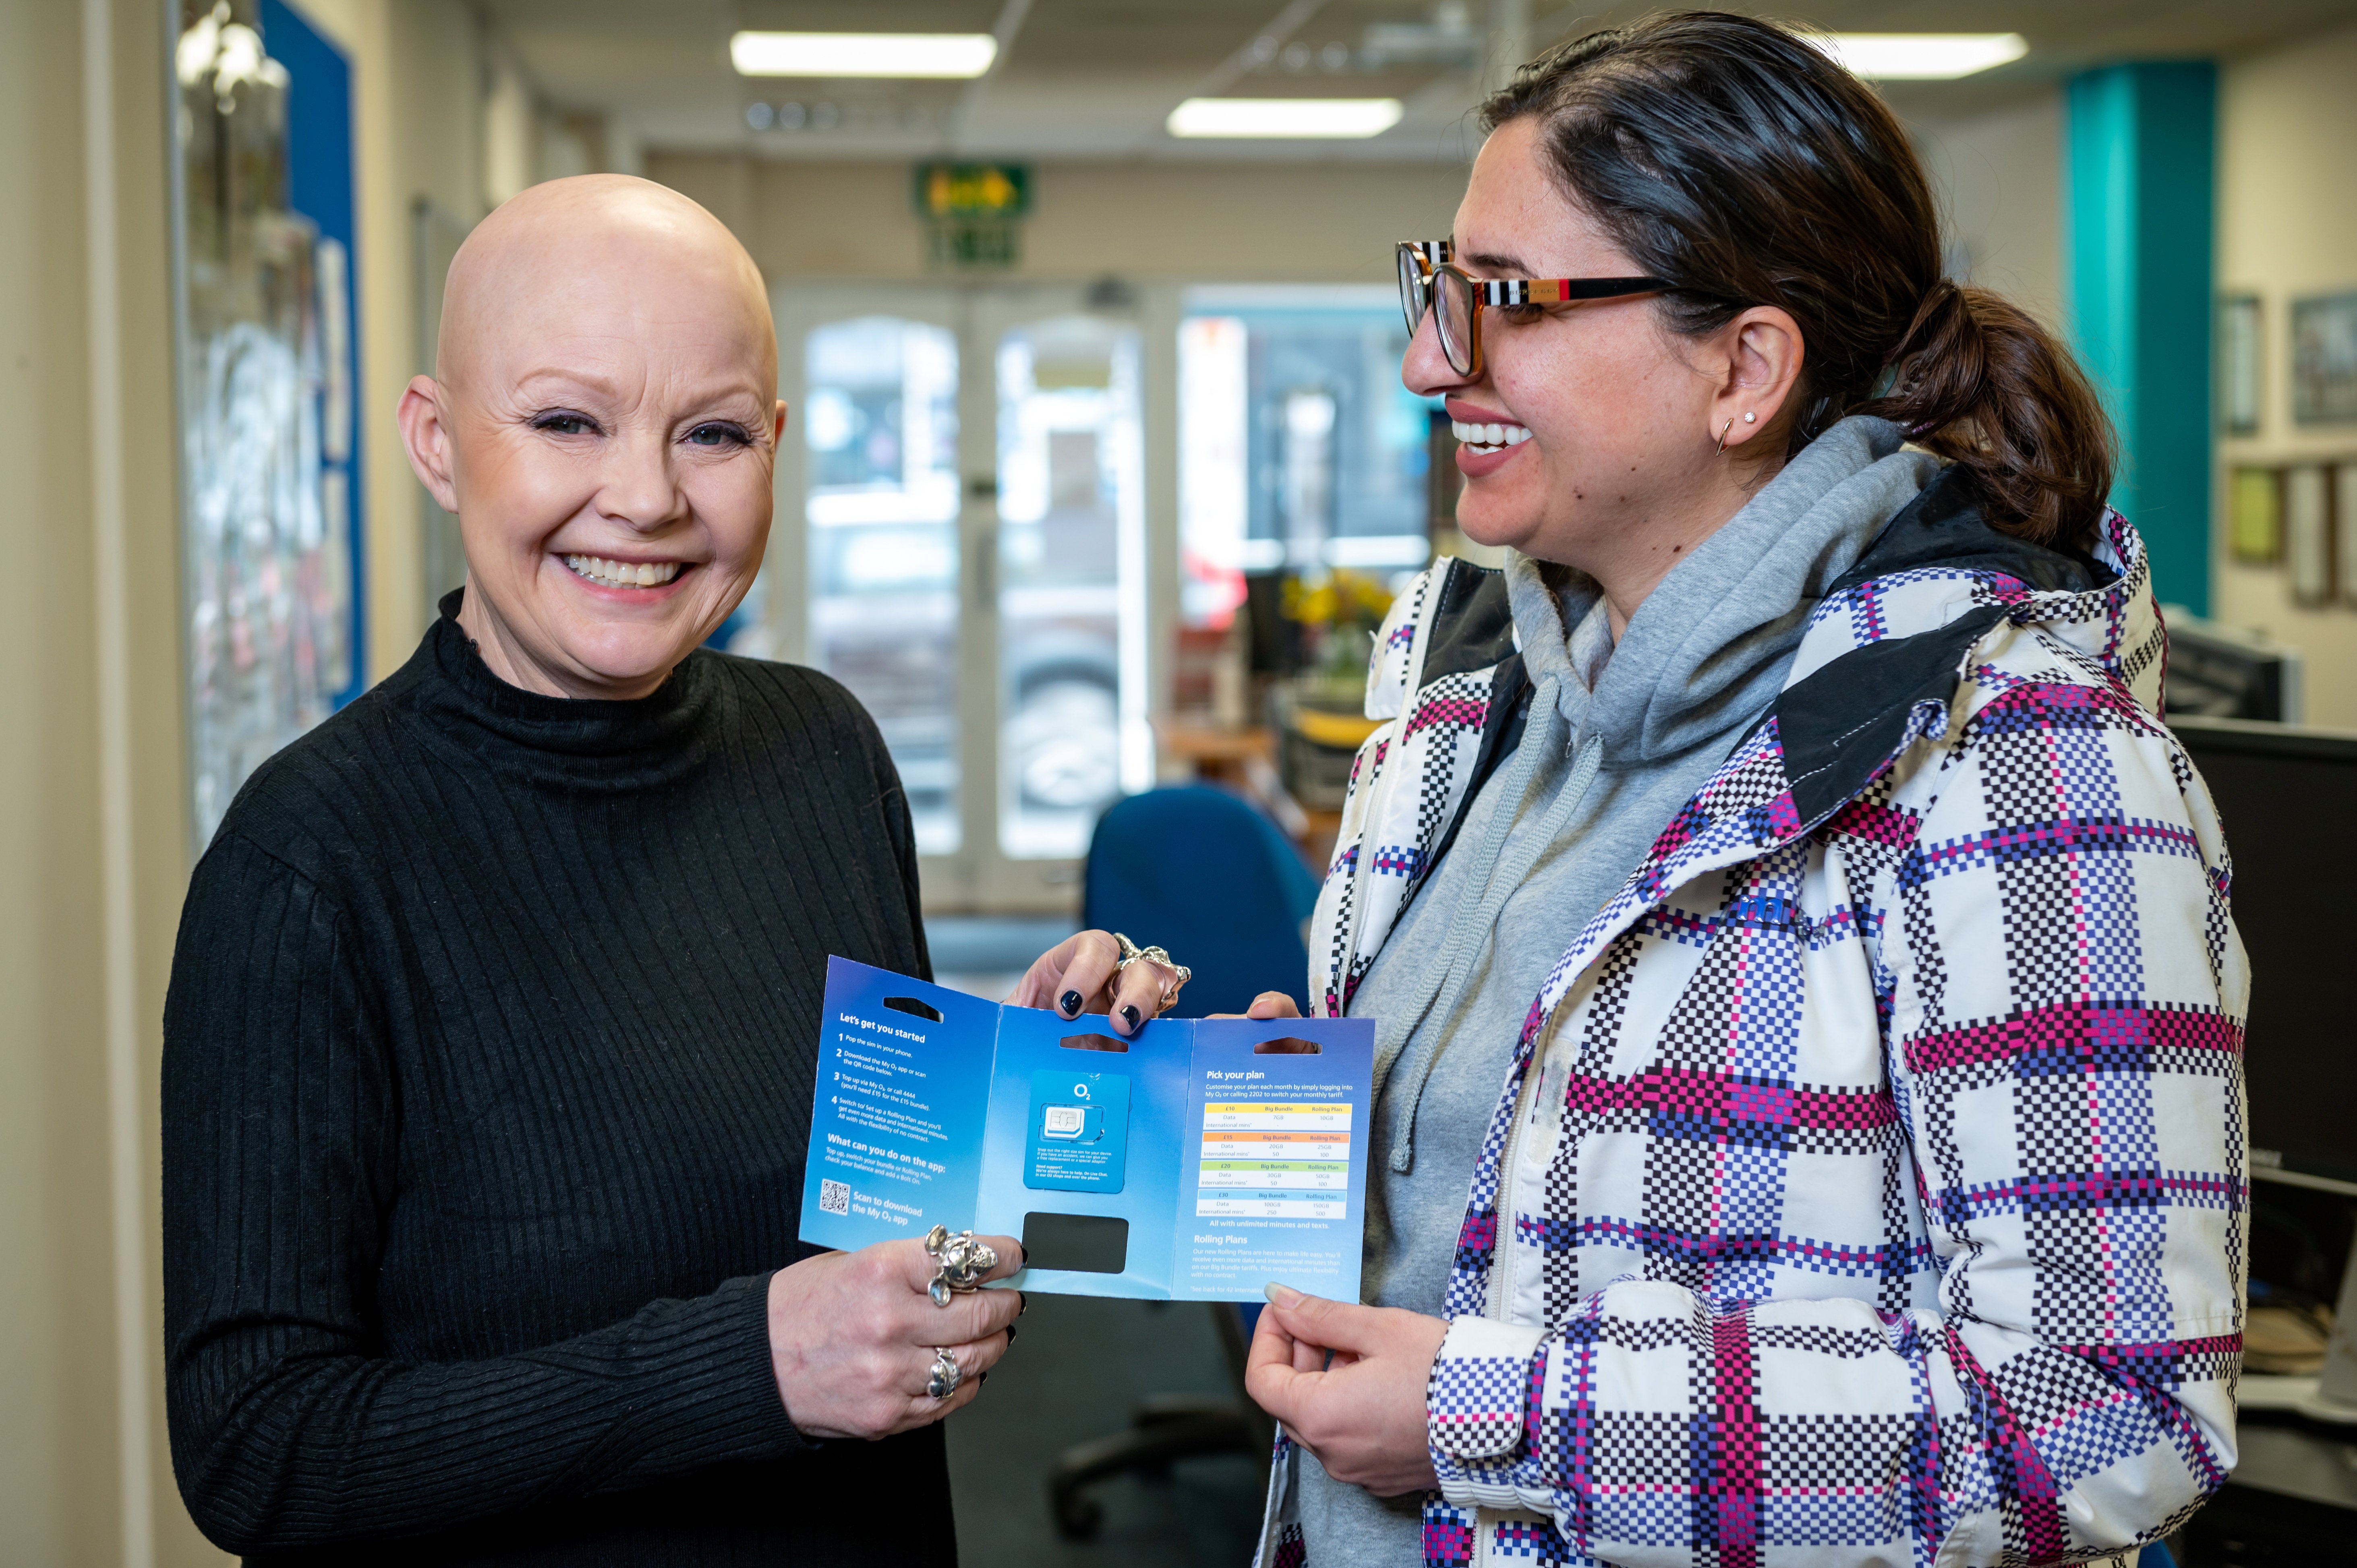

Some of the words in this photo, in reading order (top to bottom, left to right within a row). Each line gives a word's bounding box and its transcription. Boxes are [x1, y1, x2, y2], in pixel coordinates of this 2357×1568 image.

[840, 1012, 859, 1025] Let's
[861, 1020, 876, 1030] get
[877, 1024, 893, 1034] you
[895, 1029, 925, 1043] started
[839, 1033, 843, 1041] 1
[845, 1034, 856, 1043] Pop
[895, 1049, 912, 1058] phone.
[836, 1049, 842, 1057] 2
[844, 1050, 871, 1062] Download
[881, 1060, 890, 1069] My
[876, 1066, 893, 1076] below.
[834, 1072, 839, 1080] 3
[842, 1074, 851, 1082] Top
[869, 1081, 878, 1089] My
[903, 1091, 915, 1099] 4444
[1207, 1070, 1223, 1079] Pick
[1224, 1072, 1245, 1081] your
[1246, 1070, 1264, 1081] plan
[831, 1096, 837, 1104] 4
[839, 1097, 857, 1107] Switch
[887, 1110, 905, 1121] Rolling
[828, 1133, 851, 1147] What
[852, 1142, 867, 1152] can
[868, 1146, 885, 1156] you
[887, 1149, 898, 1159] do
[900, 1154, 911, 1163] on
[913, 1156, 926, 1167] the
[928, 1162, 945, 1173] app:
[852, 1203, 866, 1214] the
[867, 1206, 880, 1219] My
[882, 1210, 891, 1222] O2
[893, 1215, 908, 1226] app
[853, 1191, 872, 1204] Scan
[873, 1197, 882, 1206] to
[883, 1199, 922, 1217] download
[1194, 1235, 1223, 1245] Rolling
[1225, 1235, 1247, 1243] Plans
